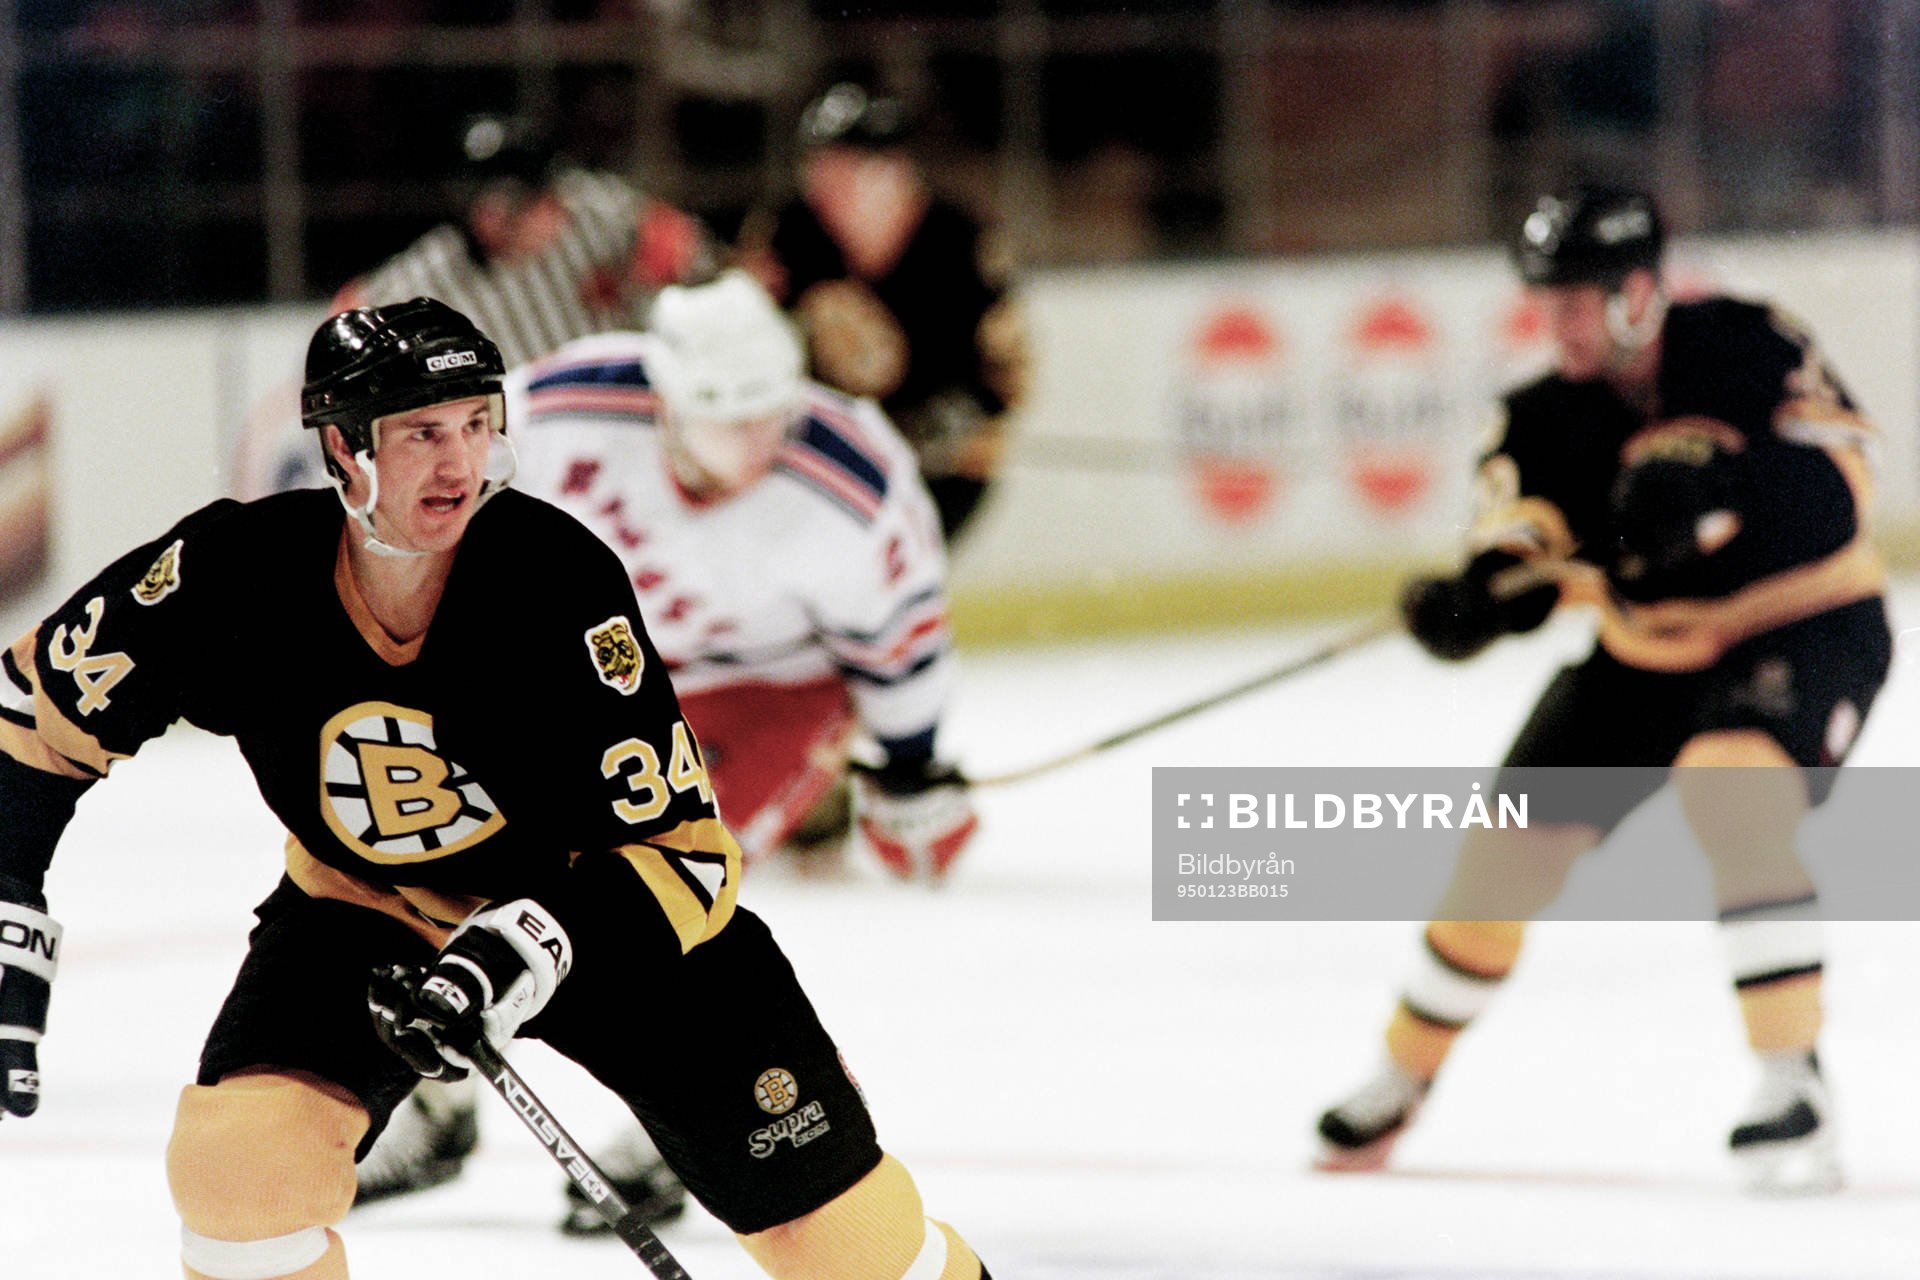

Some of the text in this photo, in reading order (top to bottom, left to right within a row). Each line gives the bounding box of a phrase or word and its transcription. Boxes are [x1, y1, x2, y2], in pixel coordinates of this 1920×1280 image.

[428, 351, 476, 370] CCM
[48, 596, 136, 717] 34
[357, 743, 463, 836] B
[600, 720, 712, 824] 34
[494, 1068, 592, 1181] EASTON
[748, 1100, 826, 1159] Supra
